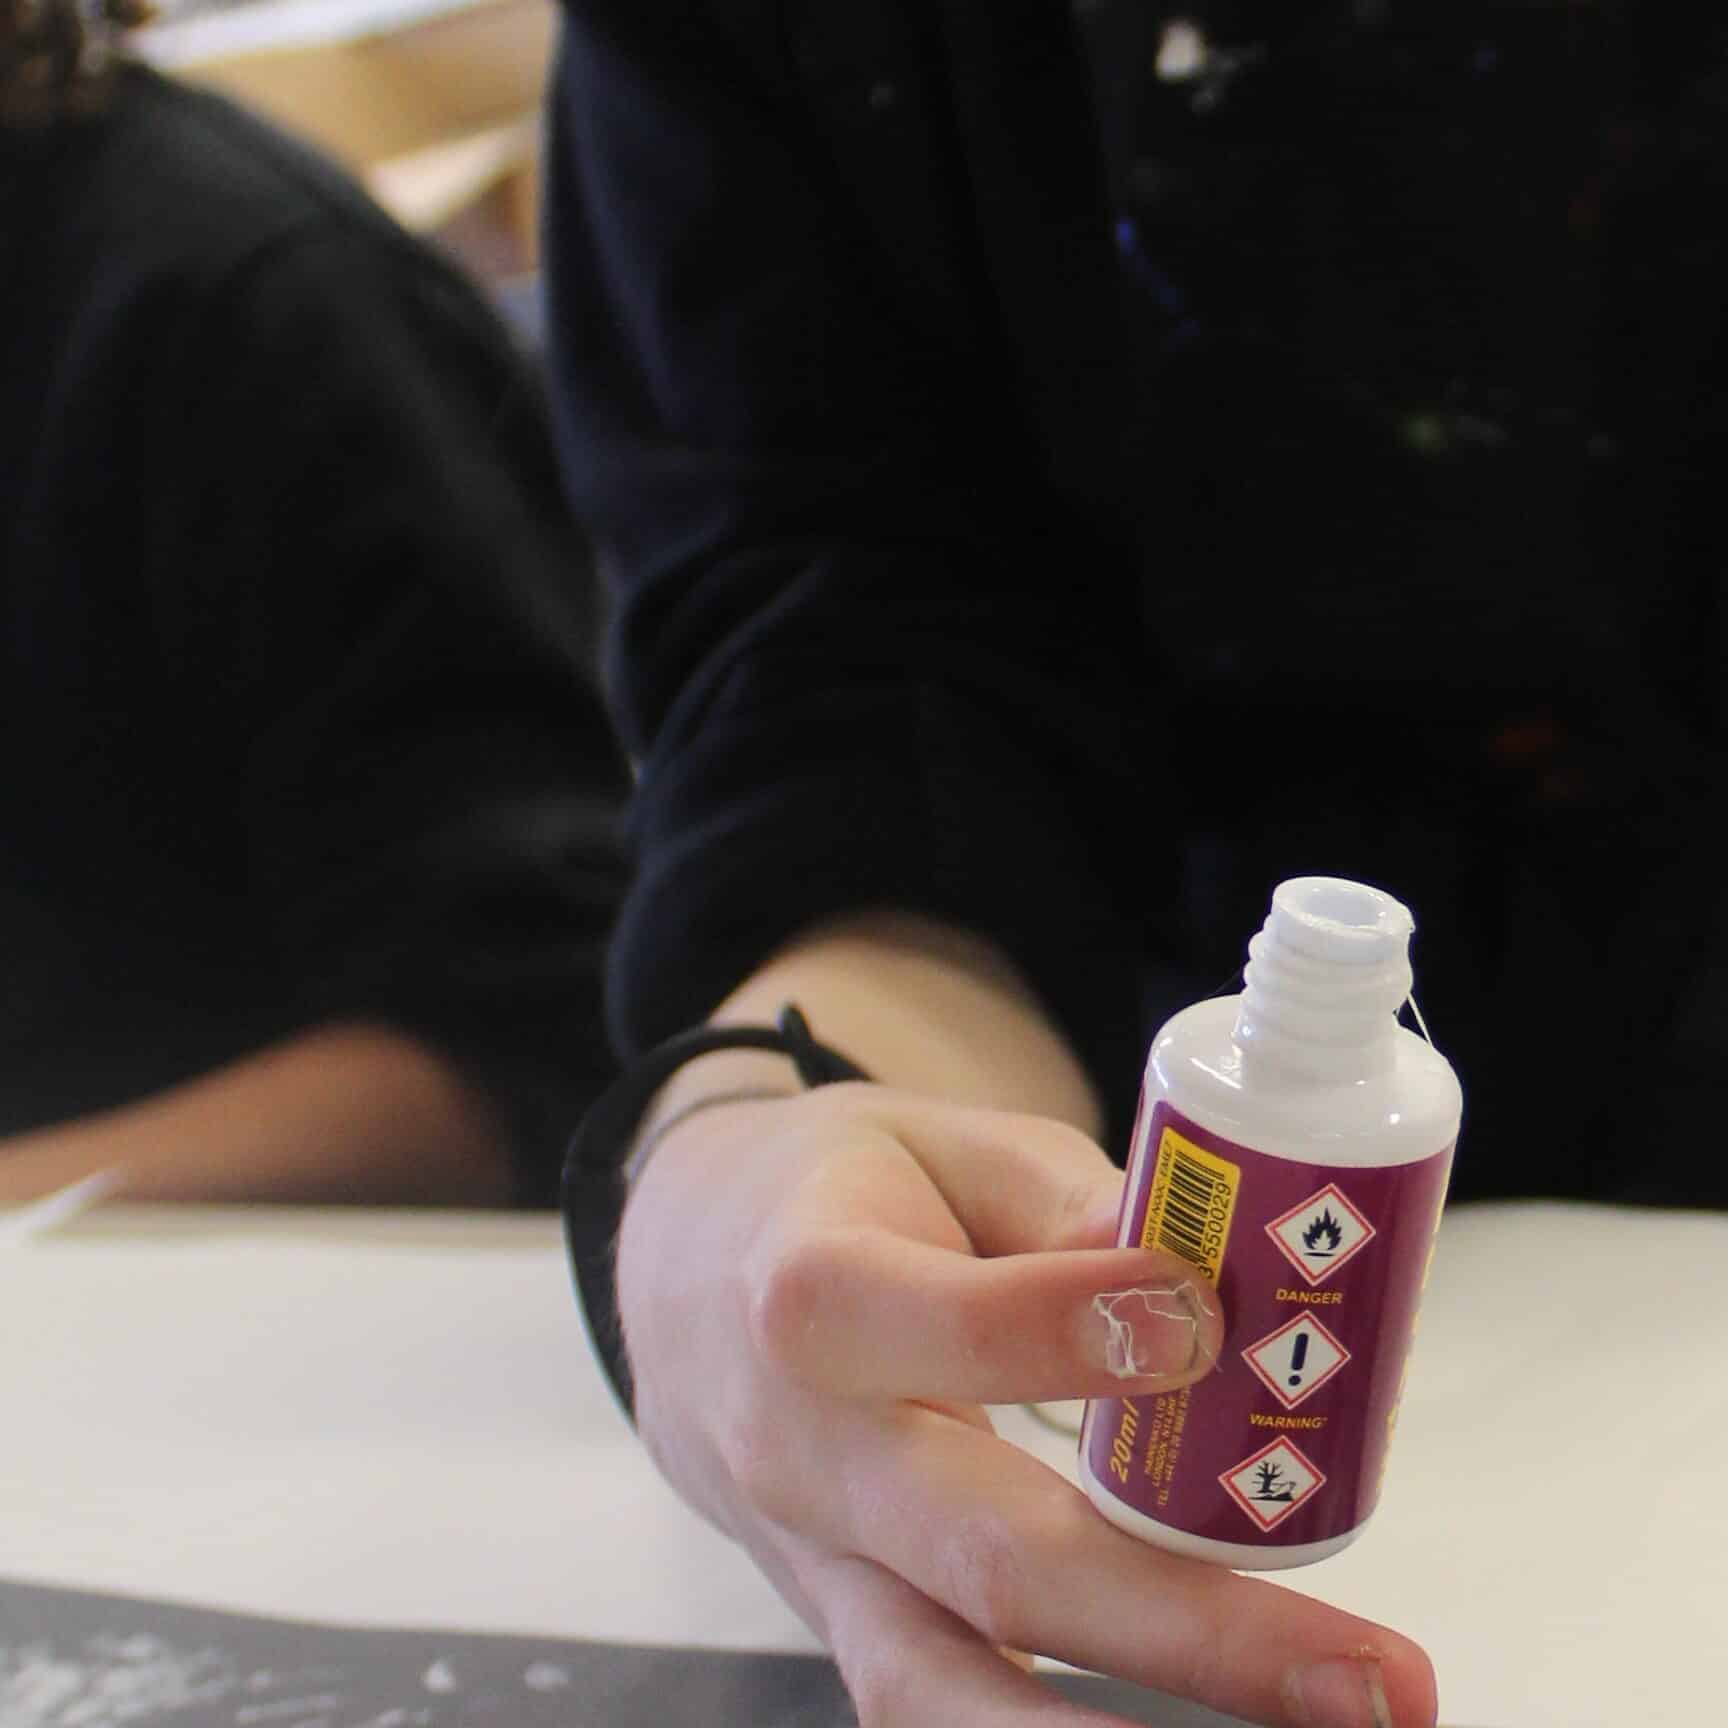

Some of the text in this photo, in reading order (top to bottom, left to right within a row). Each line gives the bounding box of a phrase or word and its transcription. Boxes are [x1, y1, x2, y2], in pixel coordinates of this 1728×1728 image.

[1203, 1183, 1232, 1258] 550029
[1275, 1288, 1343, 1304] DANGER
[1110, 1397, 1138, 1483] 20ml
